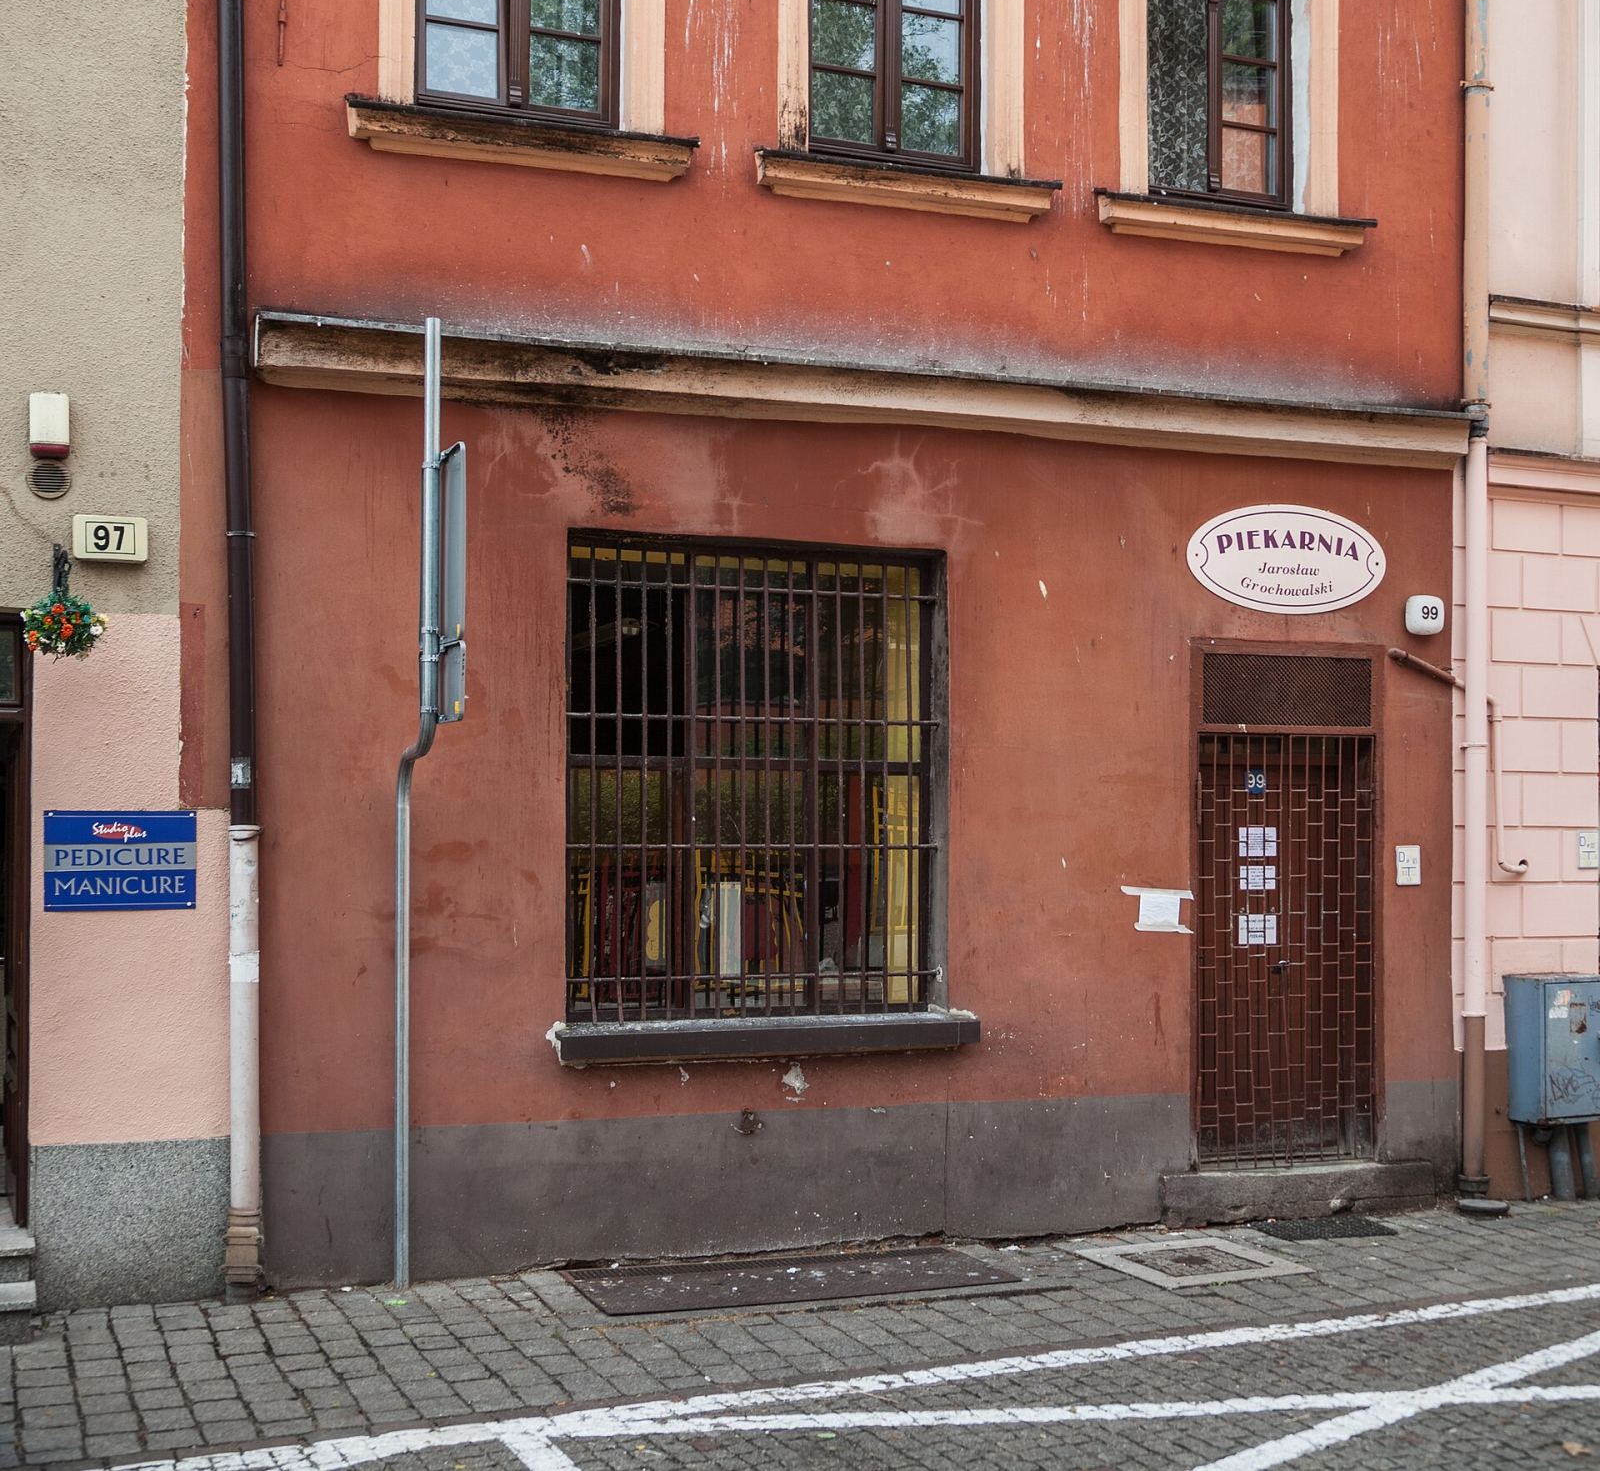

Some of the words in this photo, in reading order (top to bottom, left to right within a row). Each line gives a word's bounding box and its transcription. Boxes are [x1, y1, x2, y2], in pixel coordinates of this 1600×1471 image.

[93, 525, 125, 551] 97
[1216, 529, 1359, 561] PIEKARNIA
[1258, 562, 1320, 577] Jarosław
[1240, 576, 1334, 597] Grochowalski
[1421, 605, 1439, 620] 99
[1247, 773, 1265, 788] 99
[92, 822, 128, 835] Studio
[124, 828, 147, 843] plus
[54, 847, 187, 867] PEDICURE
[53, 876, 187, 896] MANICURE
